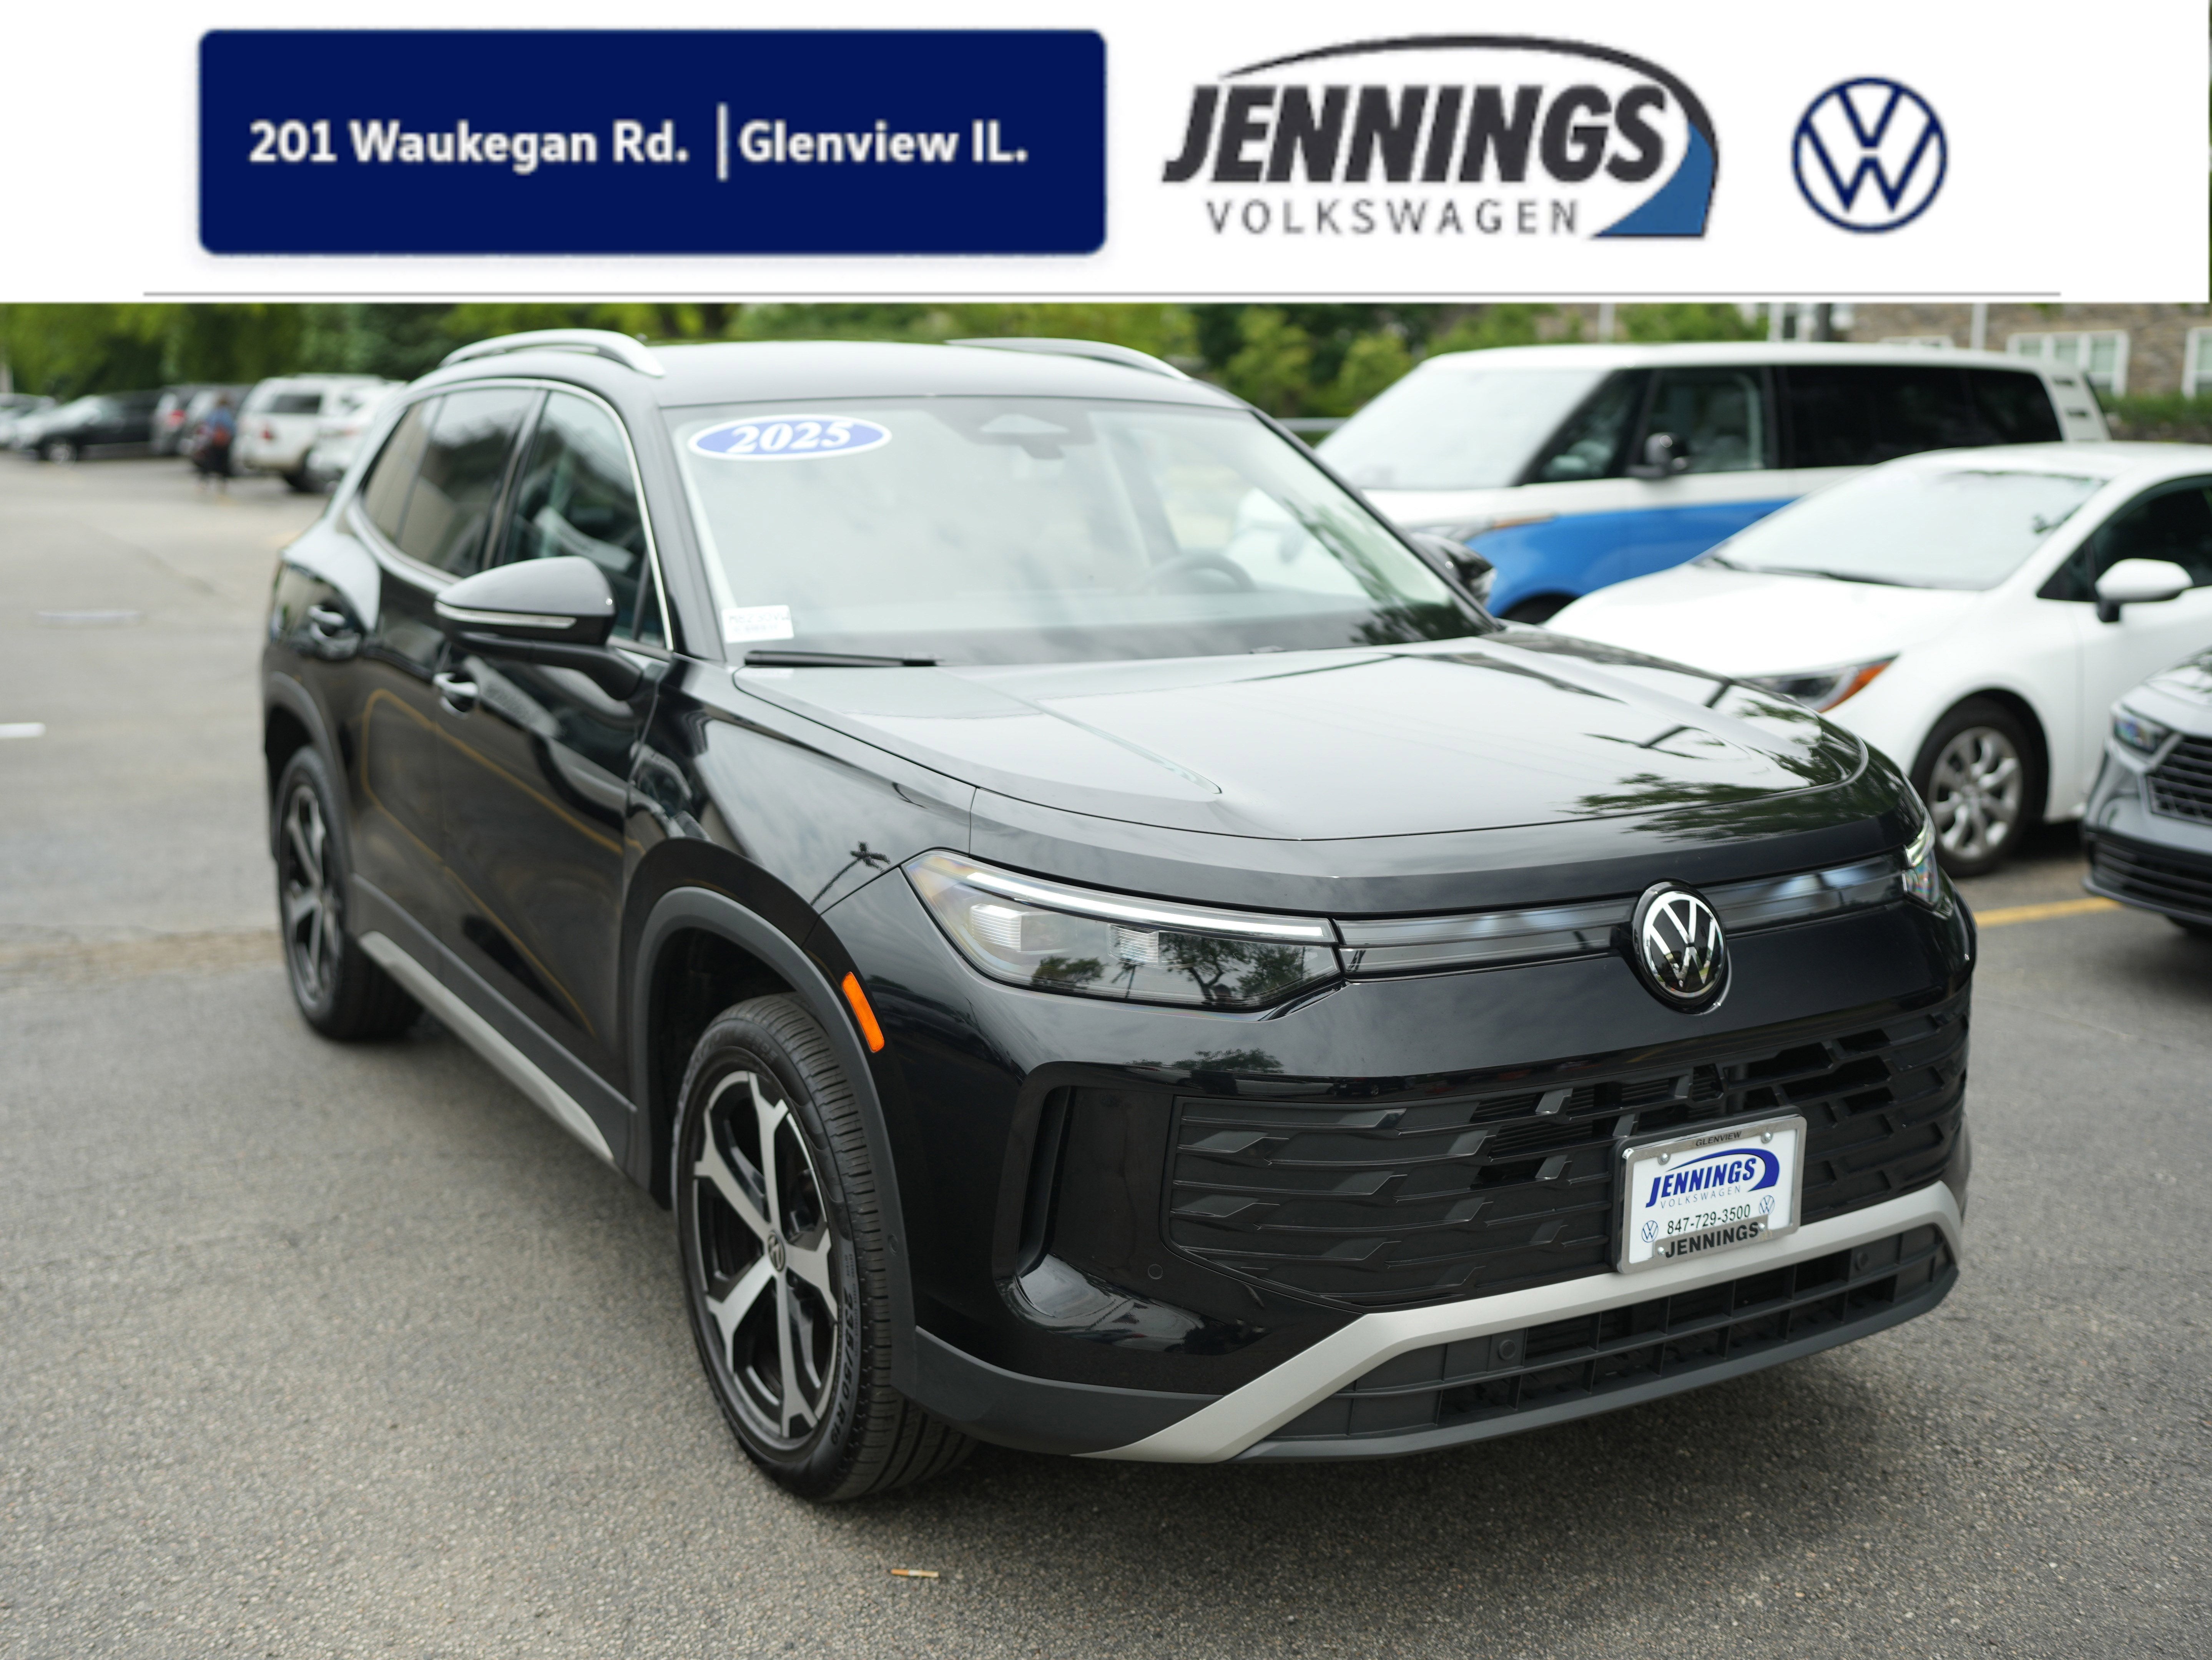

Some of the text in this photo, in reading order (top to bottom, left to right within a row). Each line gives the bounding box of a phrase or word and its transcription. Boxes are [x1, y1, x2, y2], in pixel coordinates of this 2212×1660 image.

[726, 421, 854, 454] 2025
[1695, 1130, 1742, 1146] GLENVIEW
[1645, 1157, 1757, 1208] JENNINGS
[1660, 1185, 1741, 1209] VOLKSWAGEN
[1667, 1203, 1751, 1235] 847-729-3500
[1665, 1221, 1759, 1258] JENNINGS
[842, 1287, 854, 1400] 235/50
